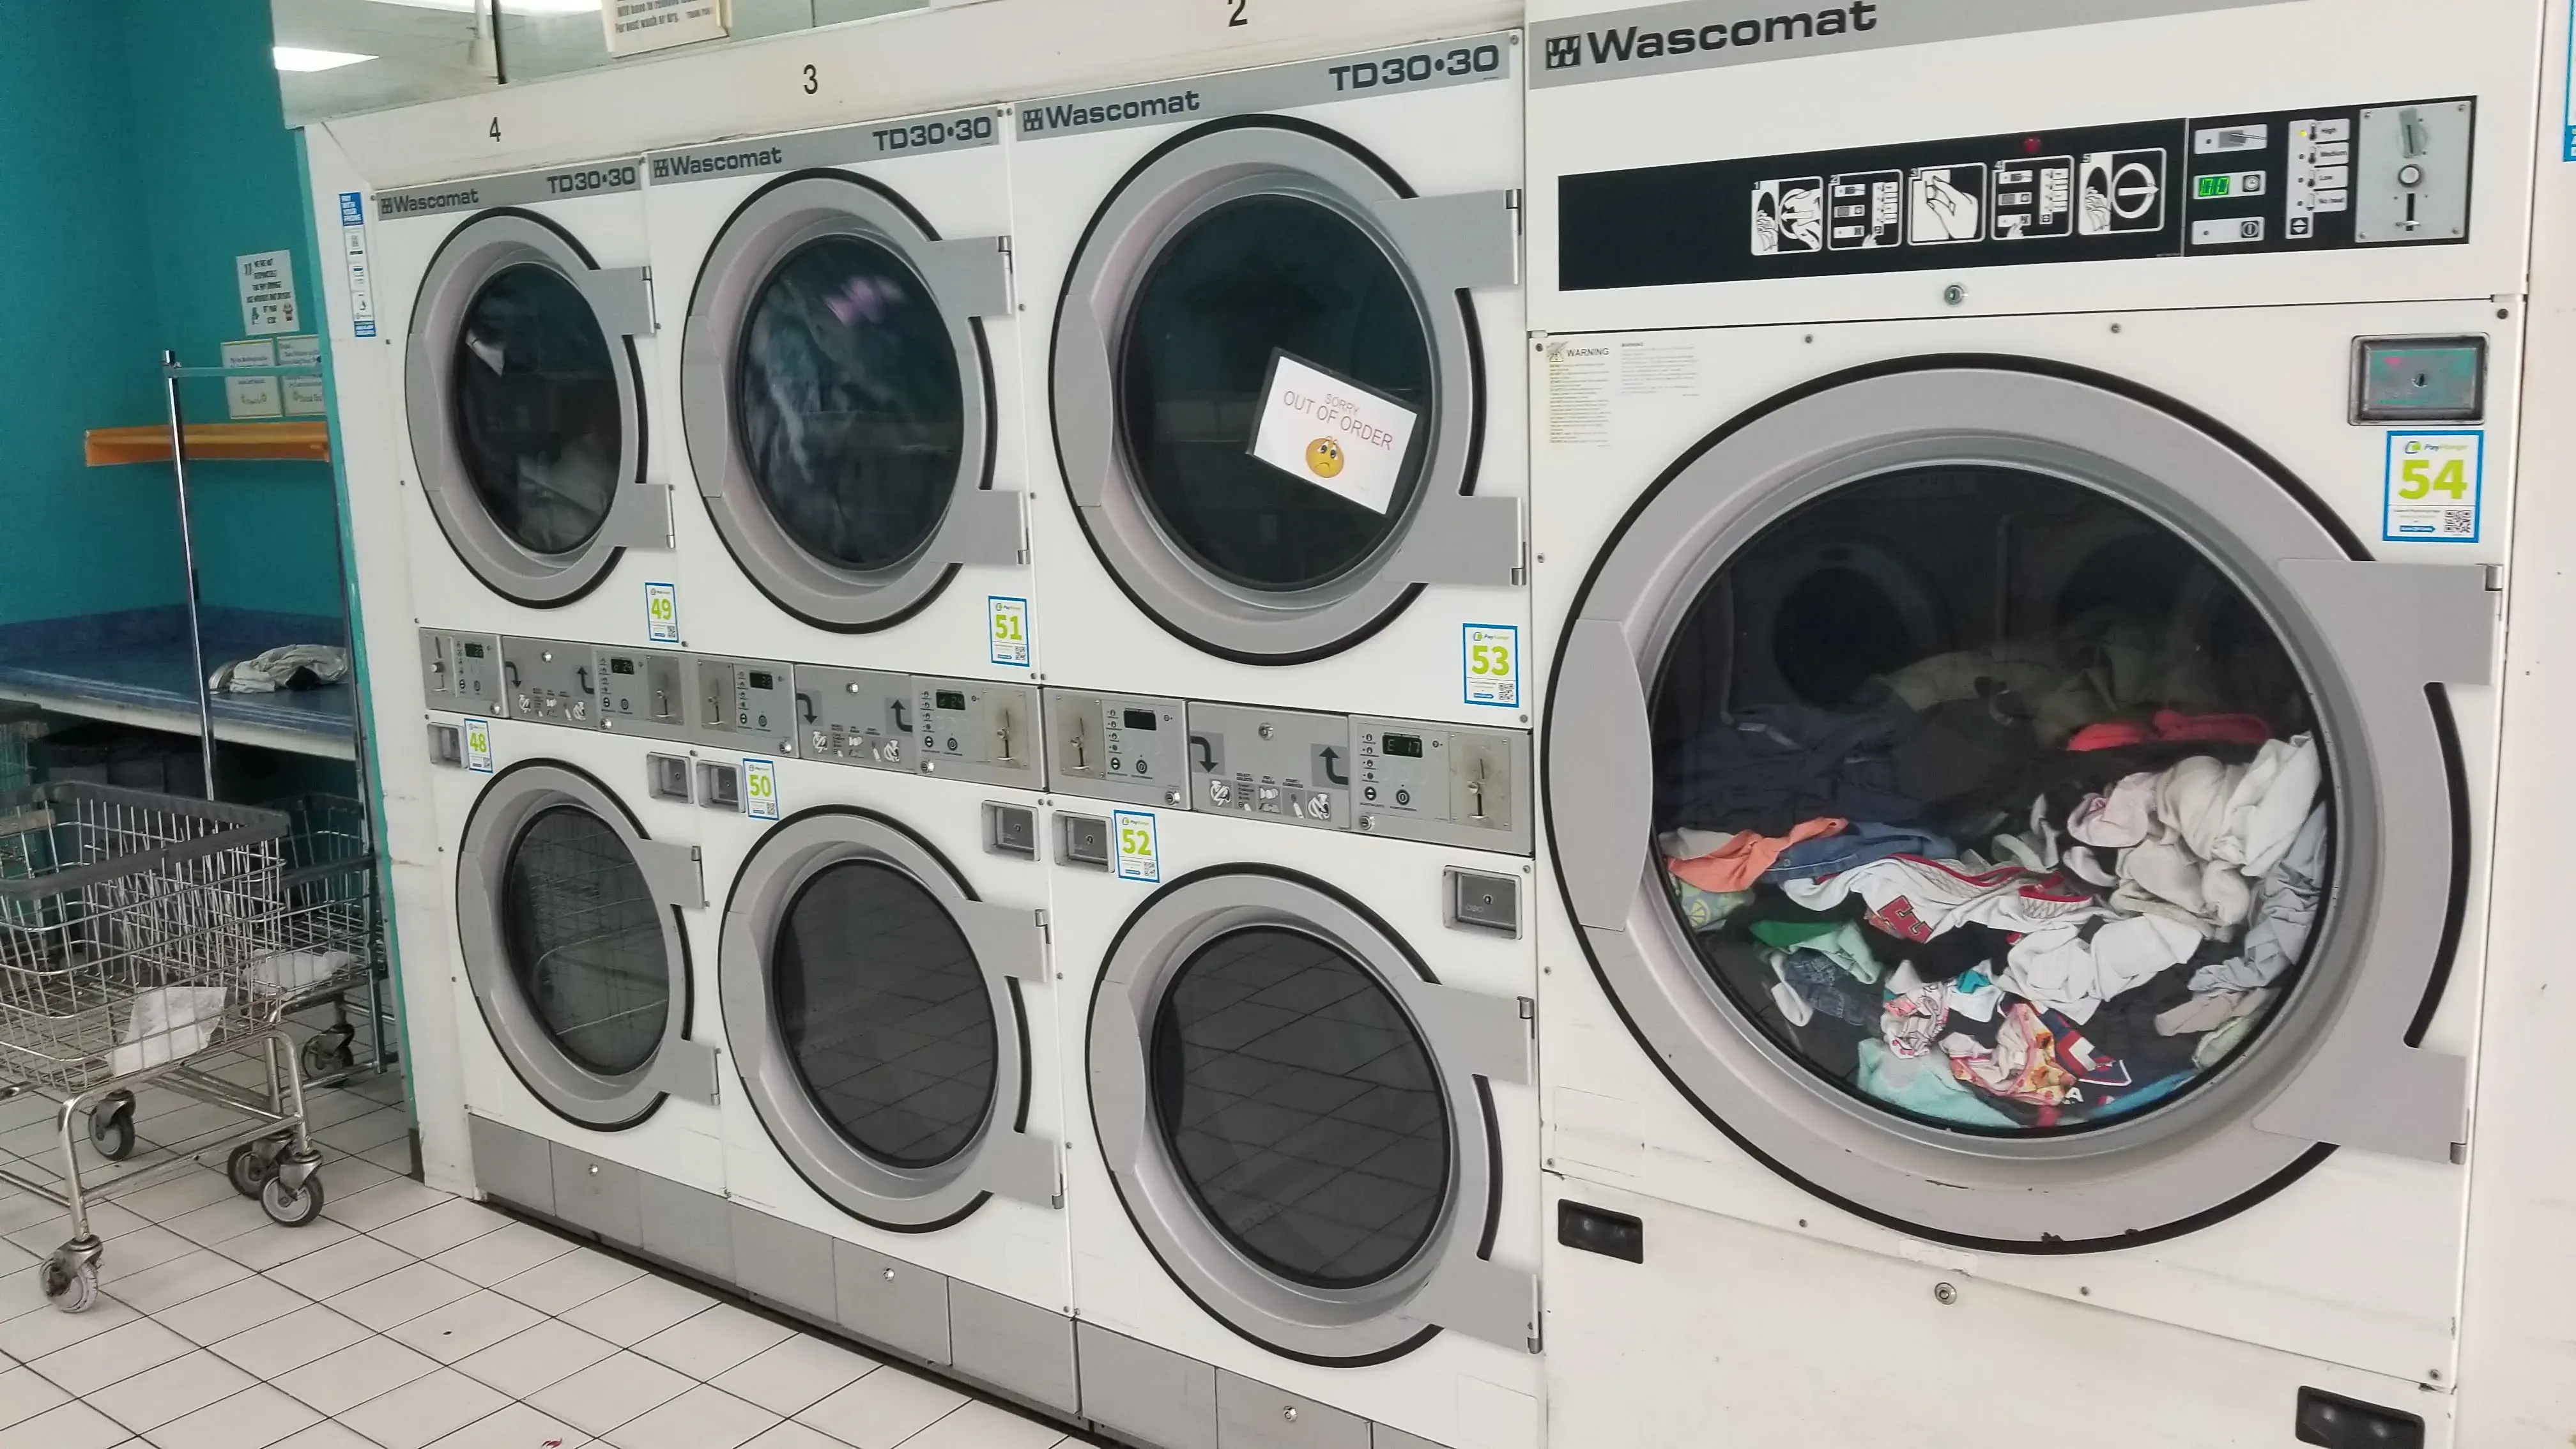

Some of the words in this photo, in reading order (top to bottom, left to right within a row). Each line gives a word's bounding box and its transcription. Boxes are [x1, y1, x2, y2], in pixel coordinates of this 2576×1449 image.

[1227, 0, 1248, 27] 2
[1587, 1, 1877, 64] Wascomat
[803, 64, 818, 94] 3
[1046, 89, 1200, 129] Wascomat
[489, 116, 502, 142] 4
[670, 146, 782, 176] Wascomat
[1830, 174, 1838, 183] 2
[393, 188, 479, 213] Wascomat
[1567, 348, 1609, 356] WARNING
[1324, 394, 1360, 416] SORRY
[1284, 390, 1315, 414] OUT
[1317, 405, 1338, 424] OF
[1340, 416, 1393, 450] ORDER
[2398, 459, 2468, 500] 54
[651, 598, 672, 620] 49
[995, 614, 1022, 640] 51
[1471, 645, 1510, 676] 53
[470, 732, 487, 753] 48
[749, 774, 772, 797] 50
[1123, 828, 1152, 856] 52
